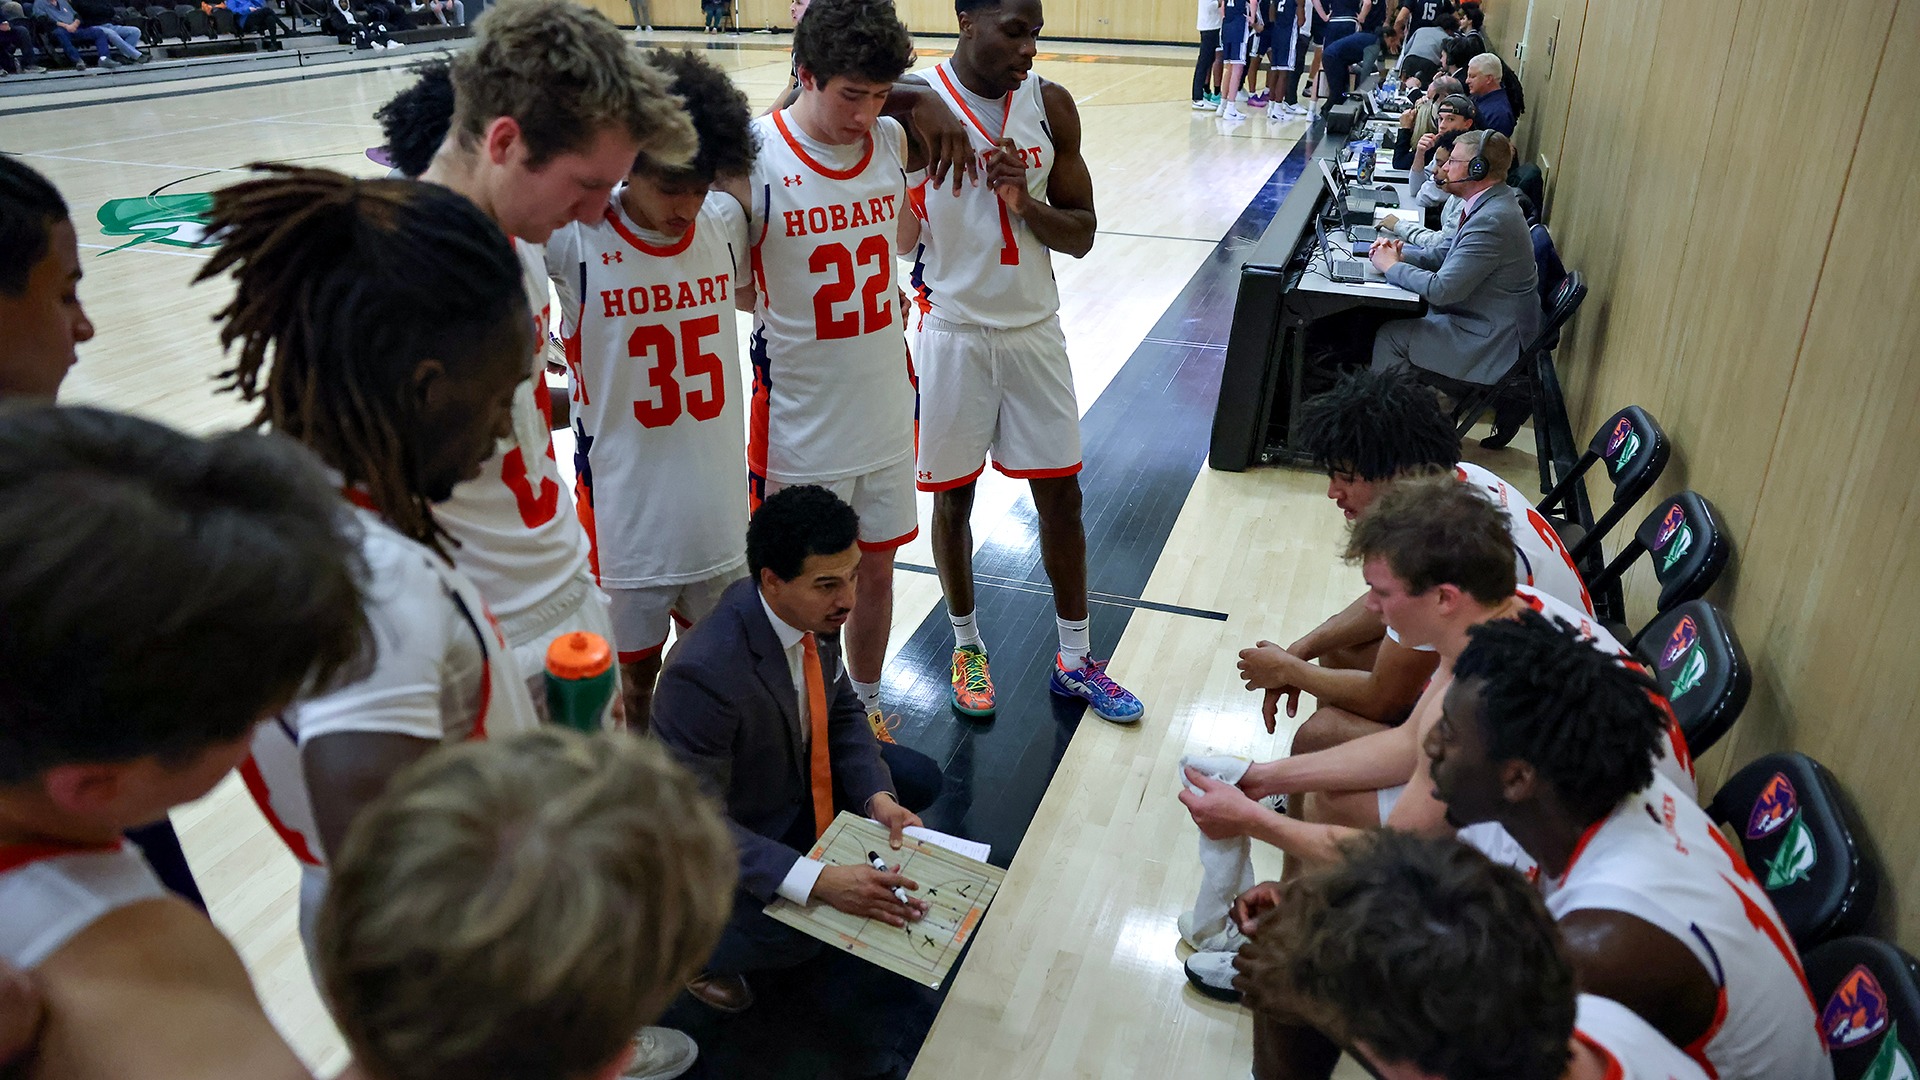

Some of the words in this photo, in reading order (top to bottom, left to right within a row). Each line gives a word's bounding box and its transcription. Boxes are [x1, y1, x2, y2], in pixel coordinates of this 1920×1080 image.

[1422, 2, 1437, 21] 15
[783, 194, 895, 237] HOBART
[600, 273, 729, 318] HOBART
[808, 233, 893, 340] 22
[627, 314, 726, 429] 35
